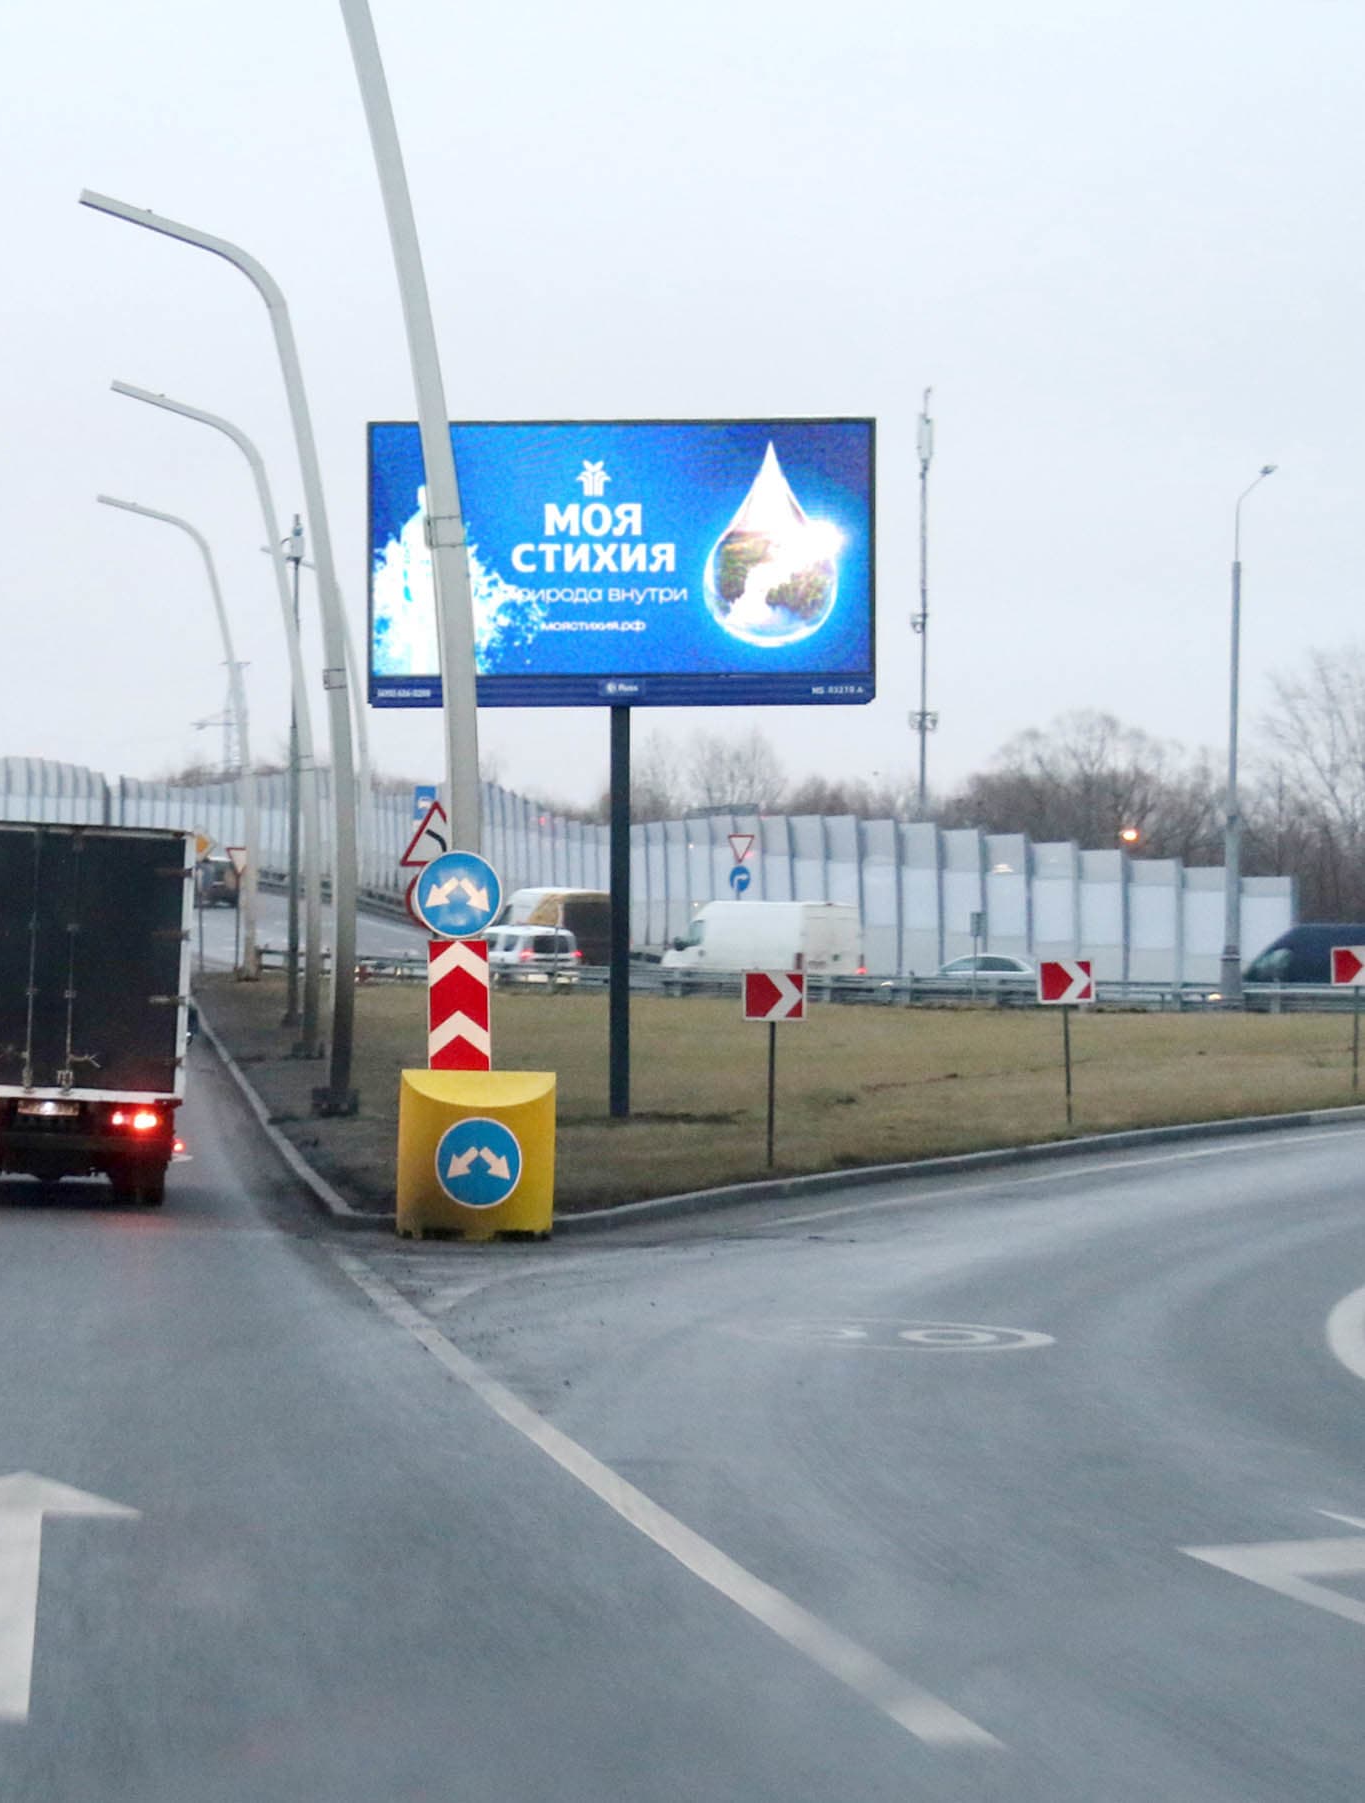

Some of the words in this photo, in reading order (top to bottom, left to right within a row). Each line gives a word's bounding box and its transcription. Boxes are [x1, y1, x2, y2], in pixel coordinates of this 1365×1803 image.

[544, 503, 642, 537] МОЯ
[511, 543, 676, 573] СТИХИЯ
[502, 587, 603, 604] рирода
[608, 587, 688, 605] внутри
